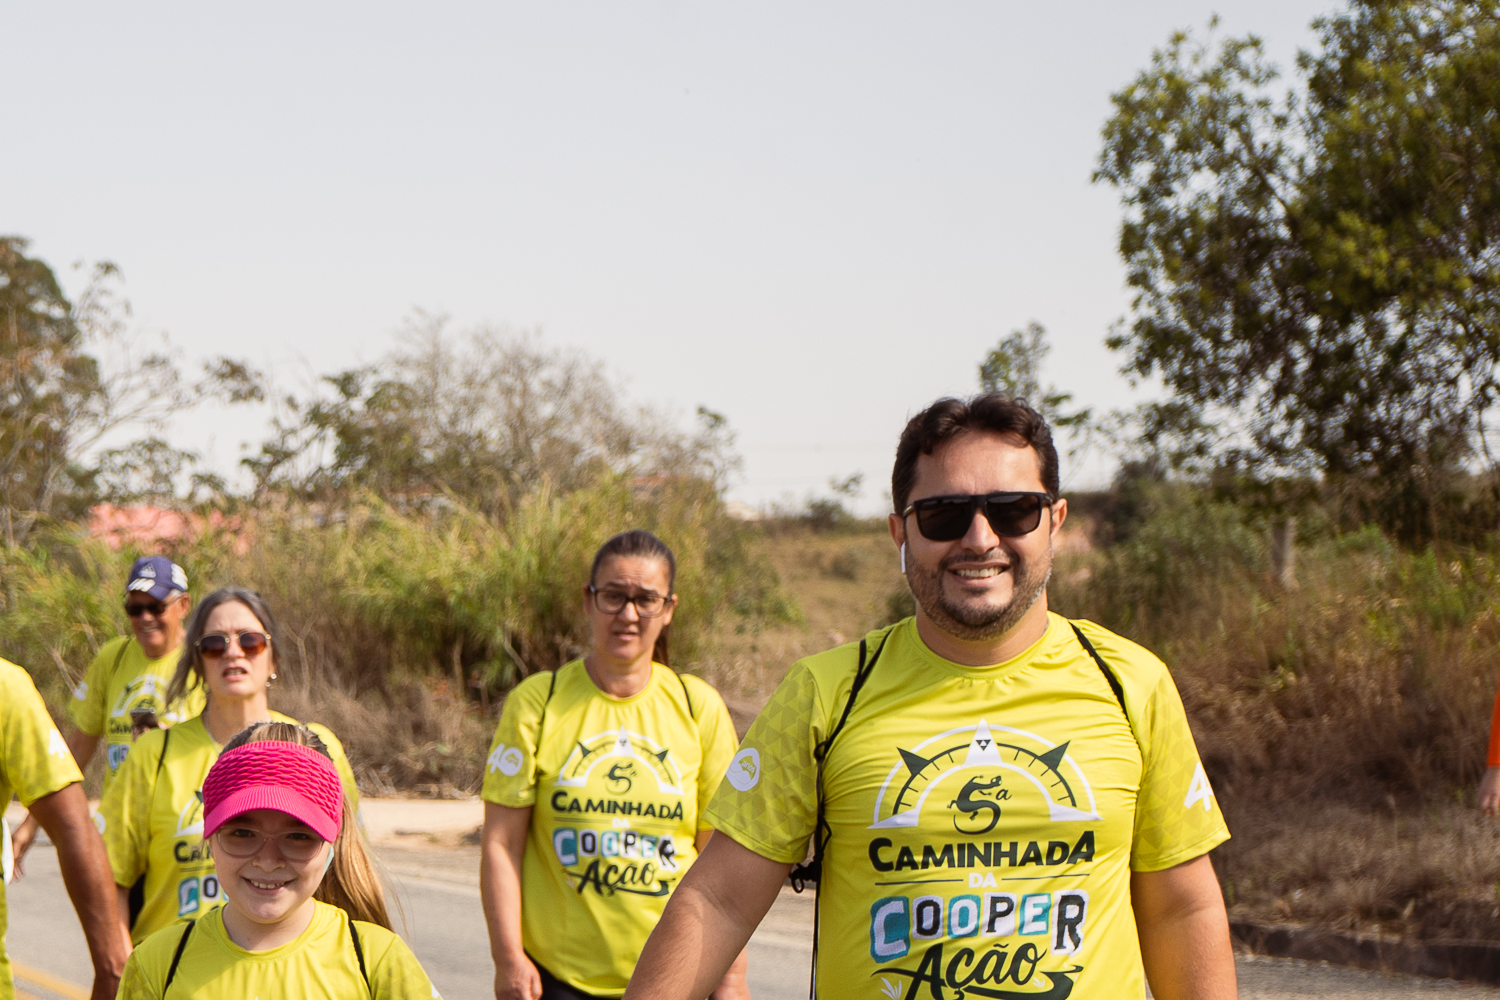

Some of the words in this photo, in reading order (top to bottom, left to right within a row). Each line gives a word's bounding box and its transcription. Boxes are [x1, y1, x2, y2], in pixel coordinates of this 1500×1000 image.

[552, 790, 683, 821] CAMINHADA
[612, 818, 630, 829] DA
[868, 830, 1096, 872] CAMINHADA
[968, 872, 998, 888] DA
[871, 892, 1087, 960] COOPER
